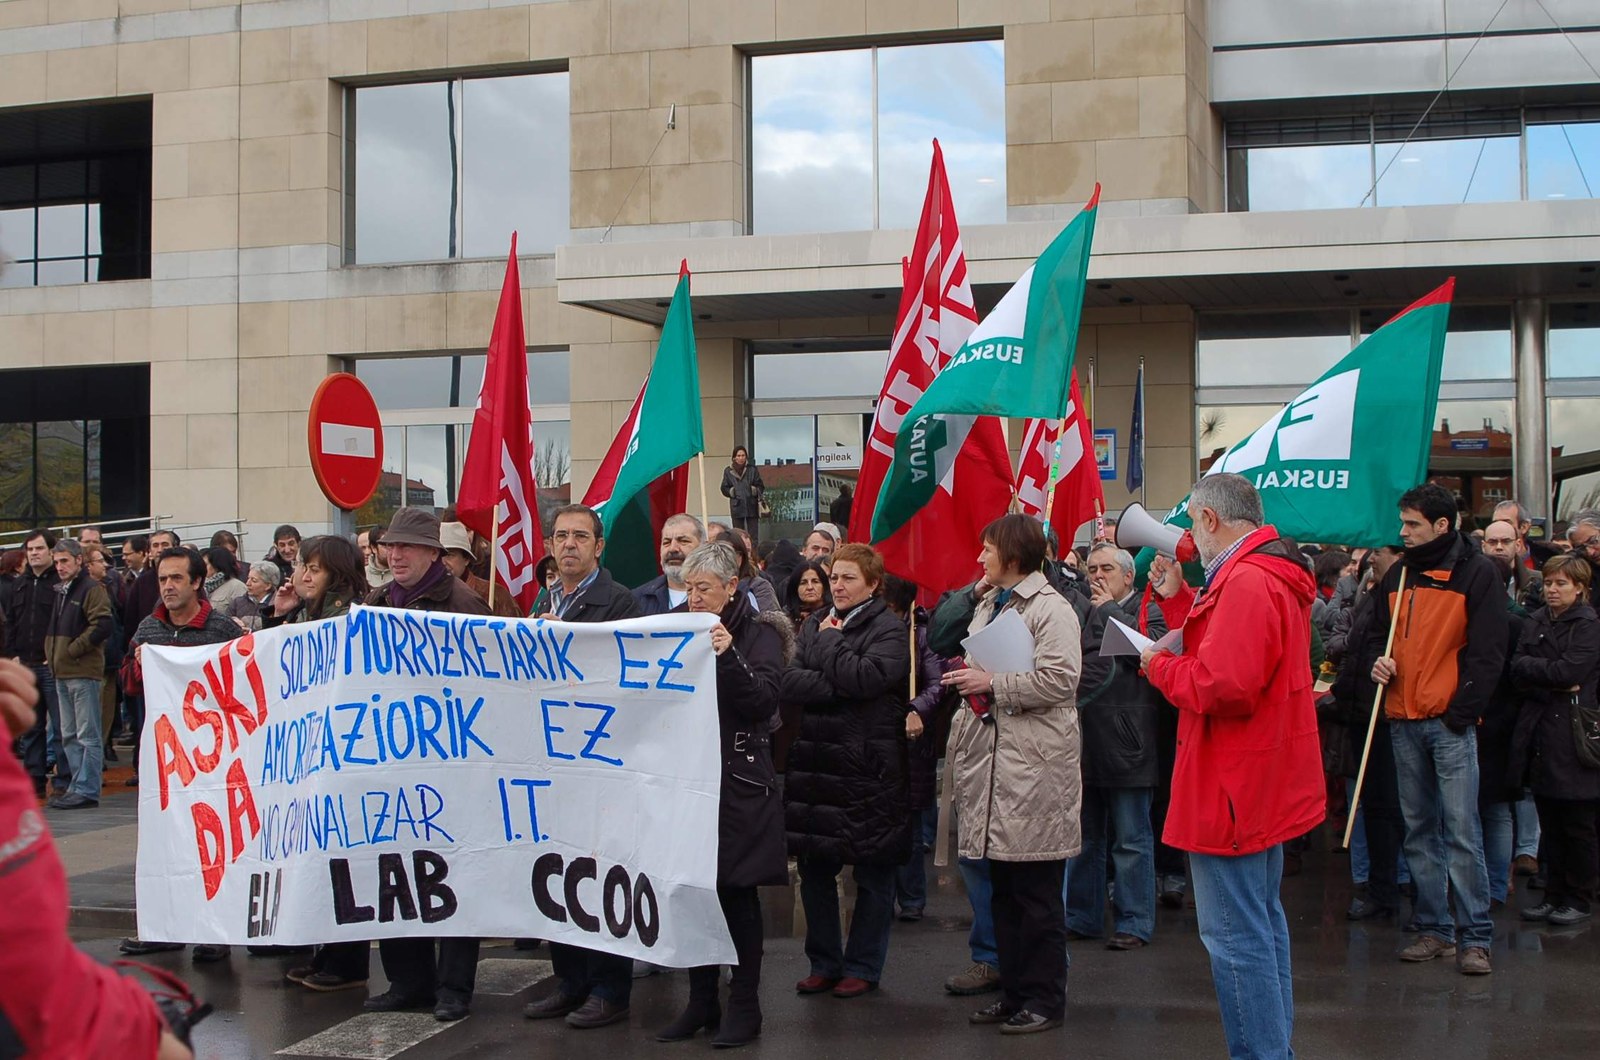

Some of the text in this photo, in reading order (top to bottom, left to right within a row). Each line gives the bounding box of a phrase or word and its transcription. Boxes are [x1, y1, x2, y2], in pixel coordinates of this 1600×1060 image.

[909, 414, 928, 483] KATUA
[280, 609, 695, 700] SOLDATA MURRIZKETARIK EZ
[540, 698, 624, 767] EZ
[190, 757, 261, 902] DA
[259, 803, 280, 862] NO
[497, 777, 552, 845] I.T.
[247, 849, 660, 948] ELA LAB CCOO
